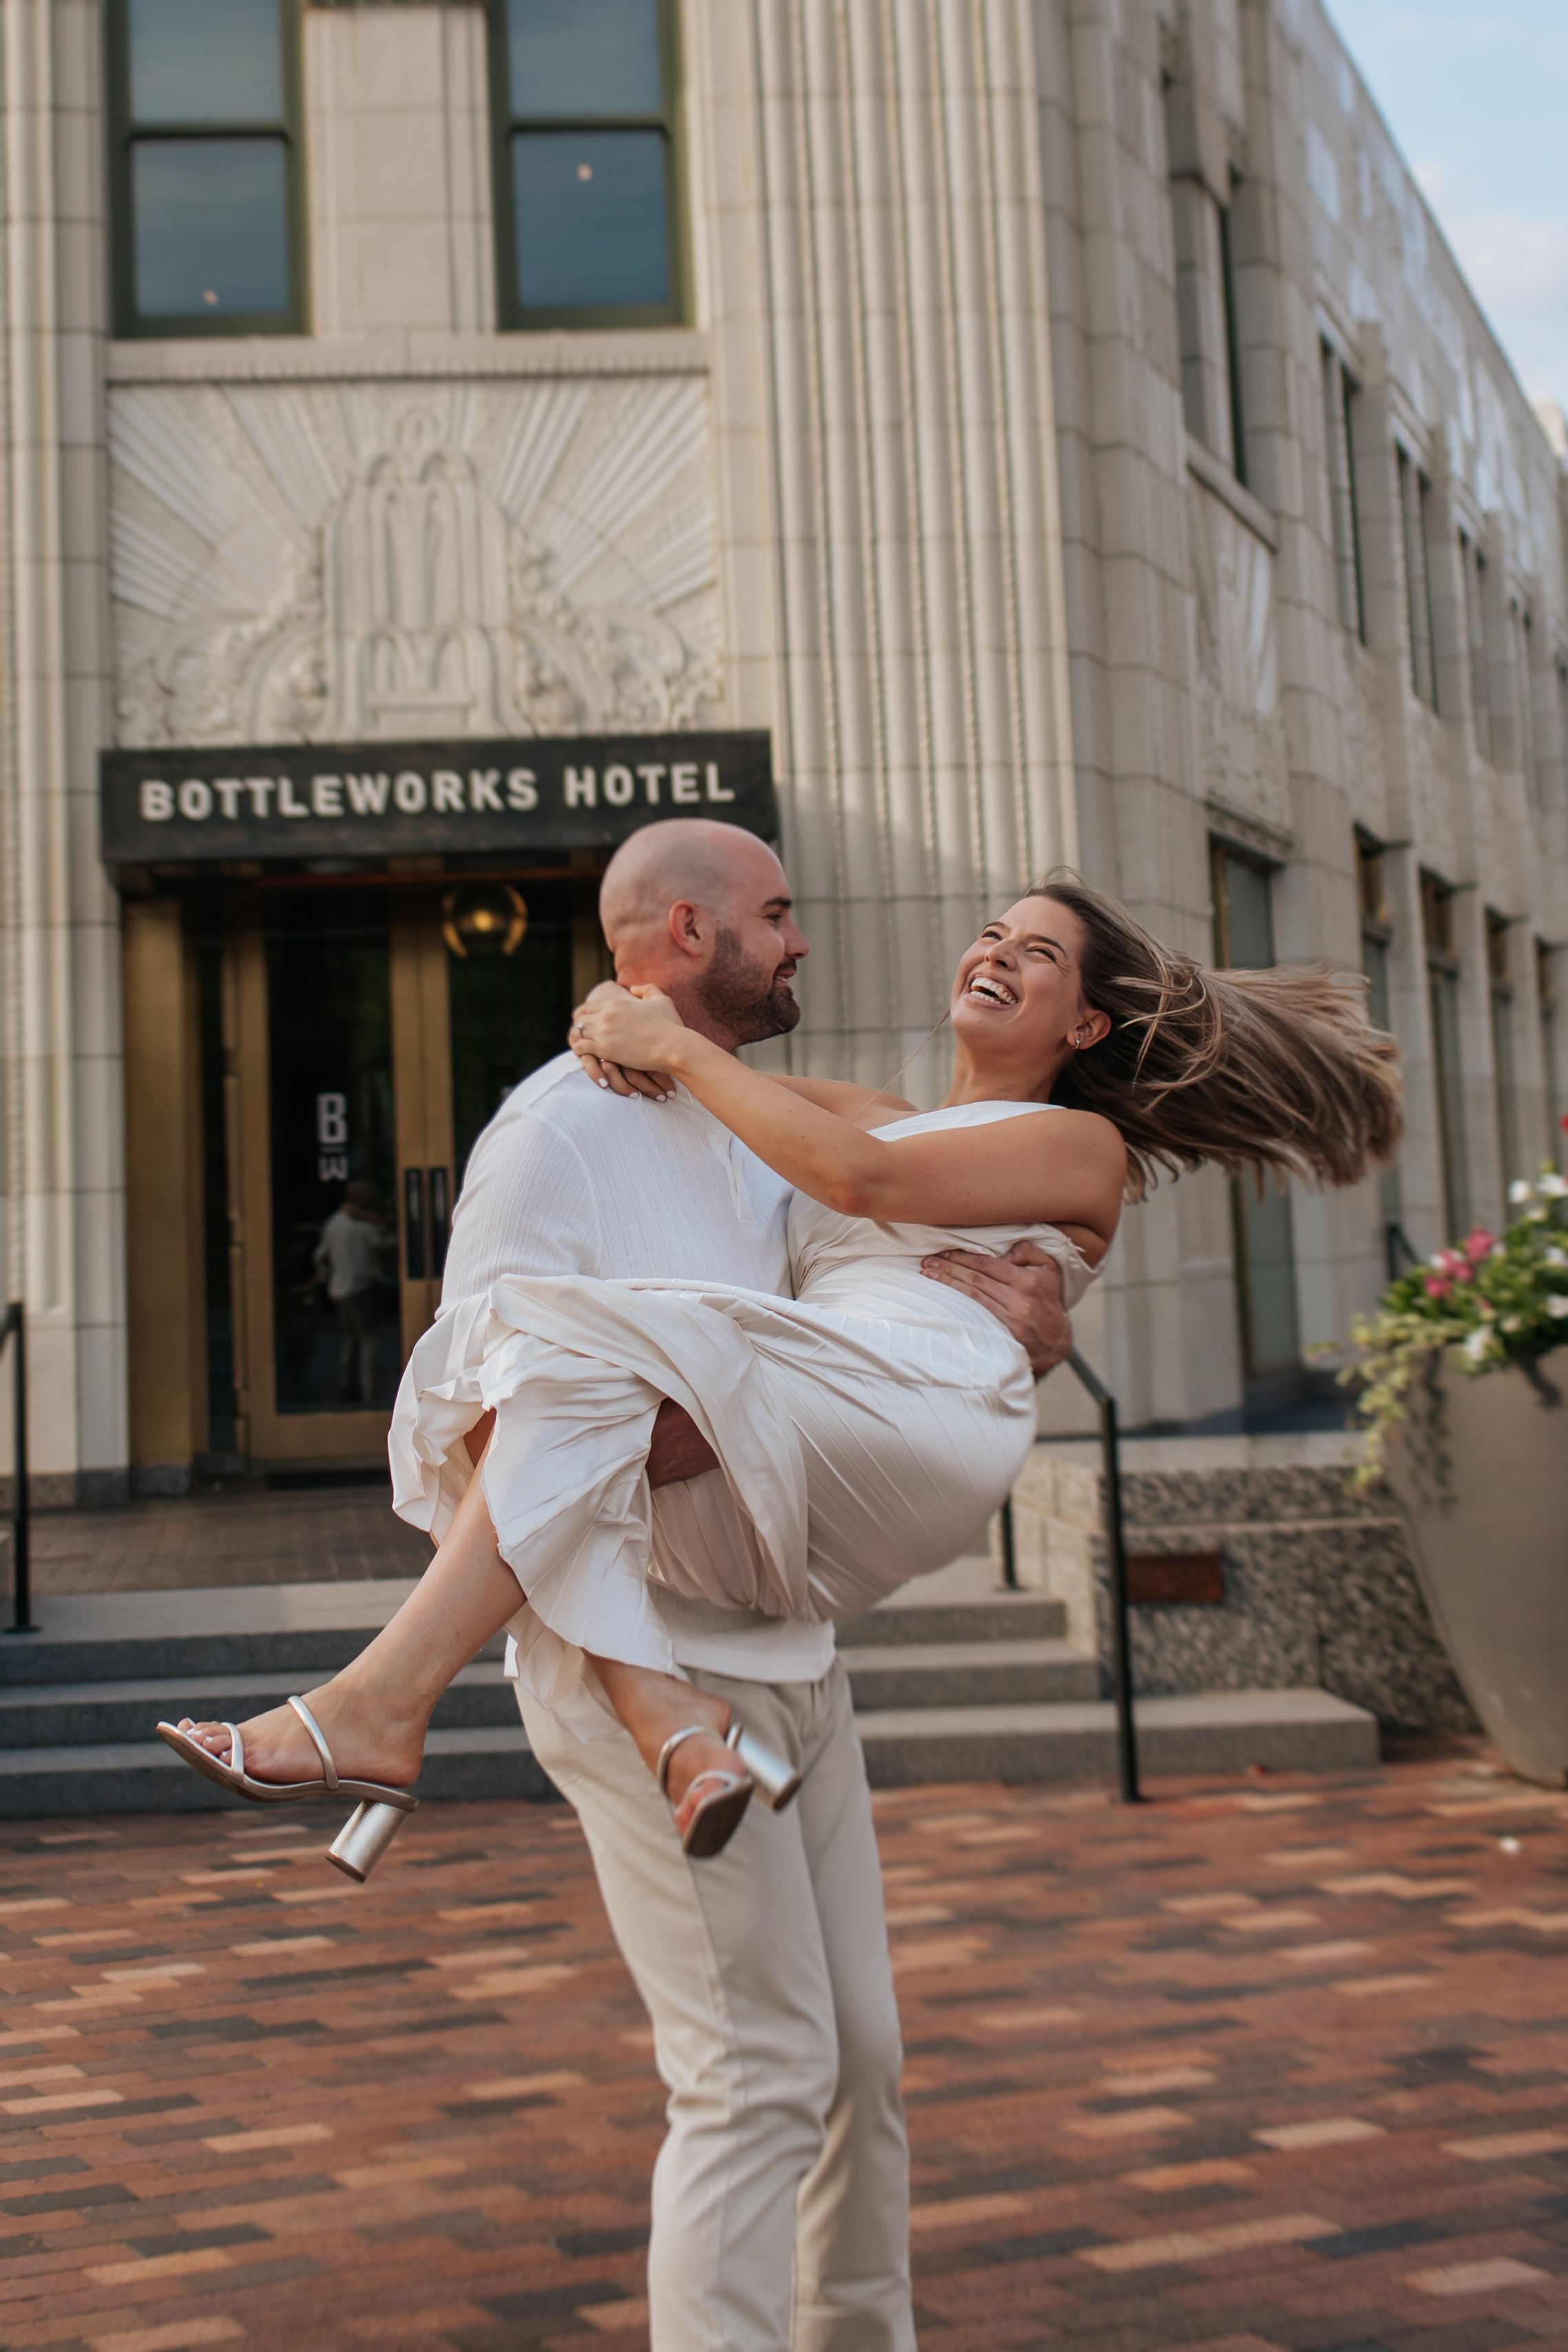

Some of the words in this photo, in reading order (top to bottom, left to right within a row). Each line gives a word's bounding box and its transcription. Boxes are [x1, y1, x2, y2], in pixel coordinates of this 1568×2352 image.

[141, 768, 538, 820] BOTTLEWORKS
[564, 762, 735, 806] HOTEL
[317, 1092, 347, 1144] B
